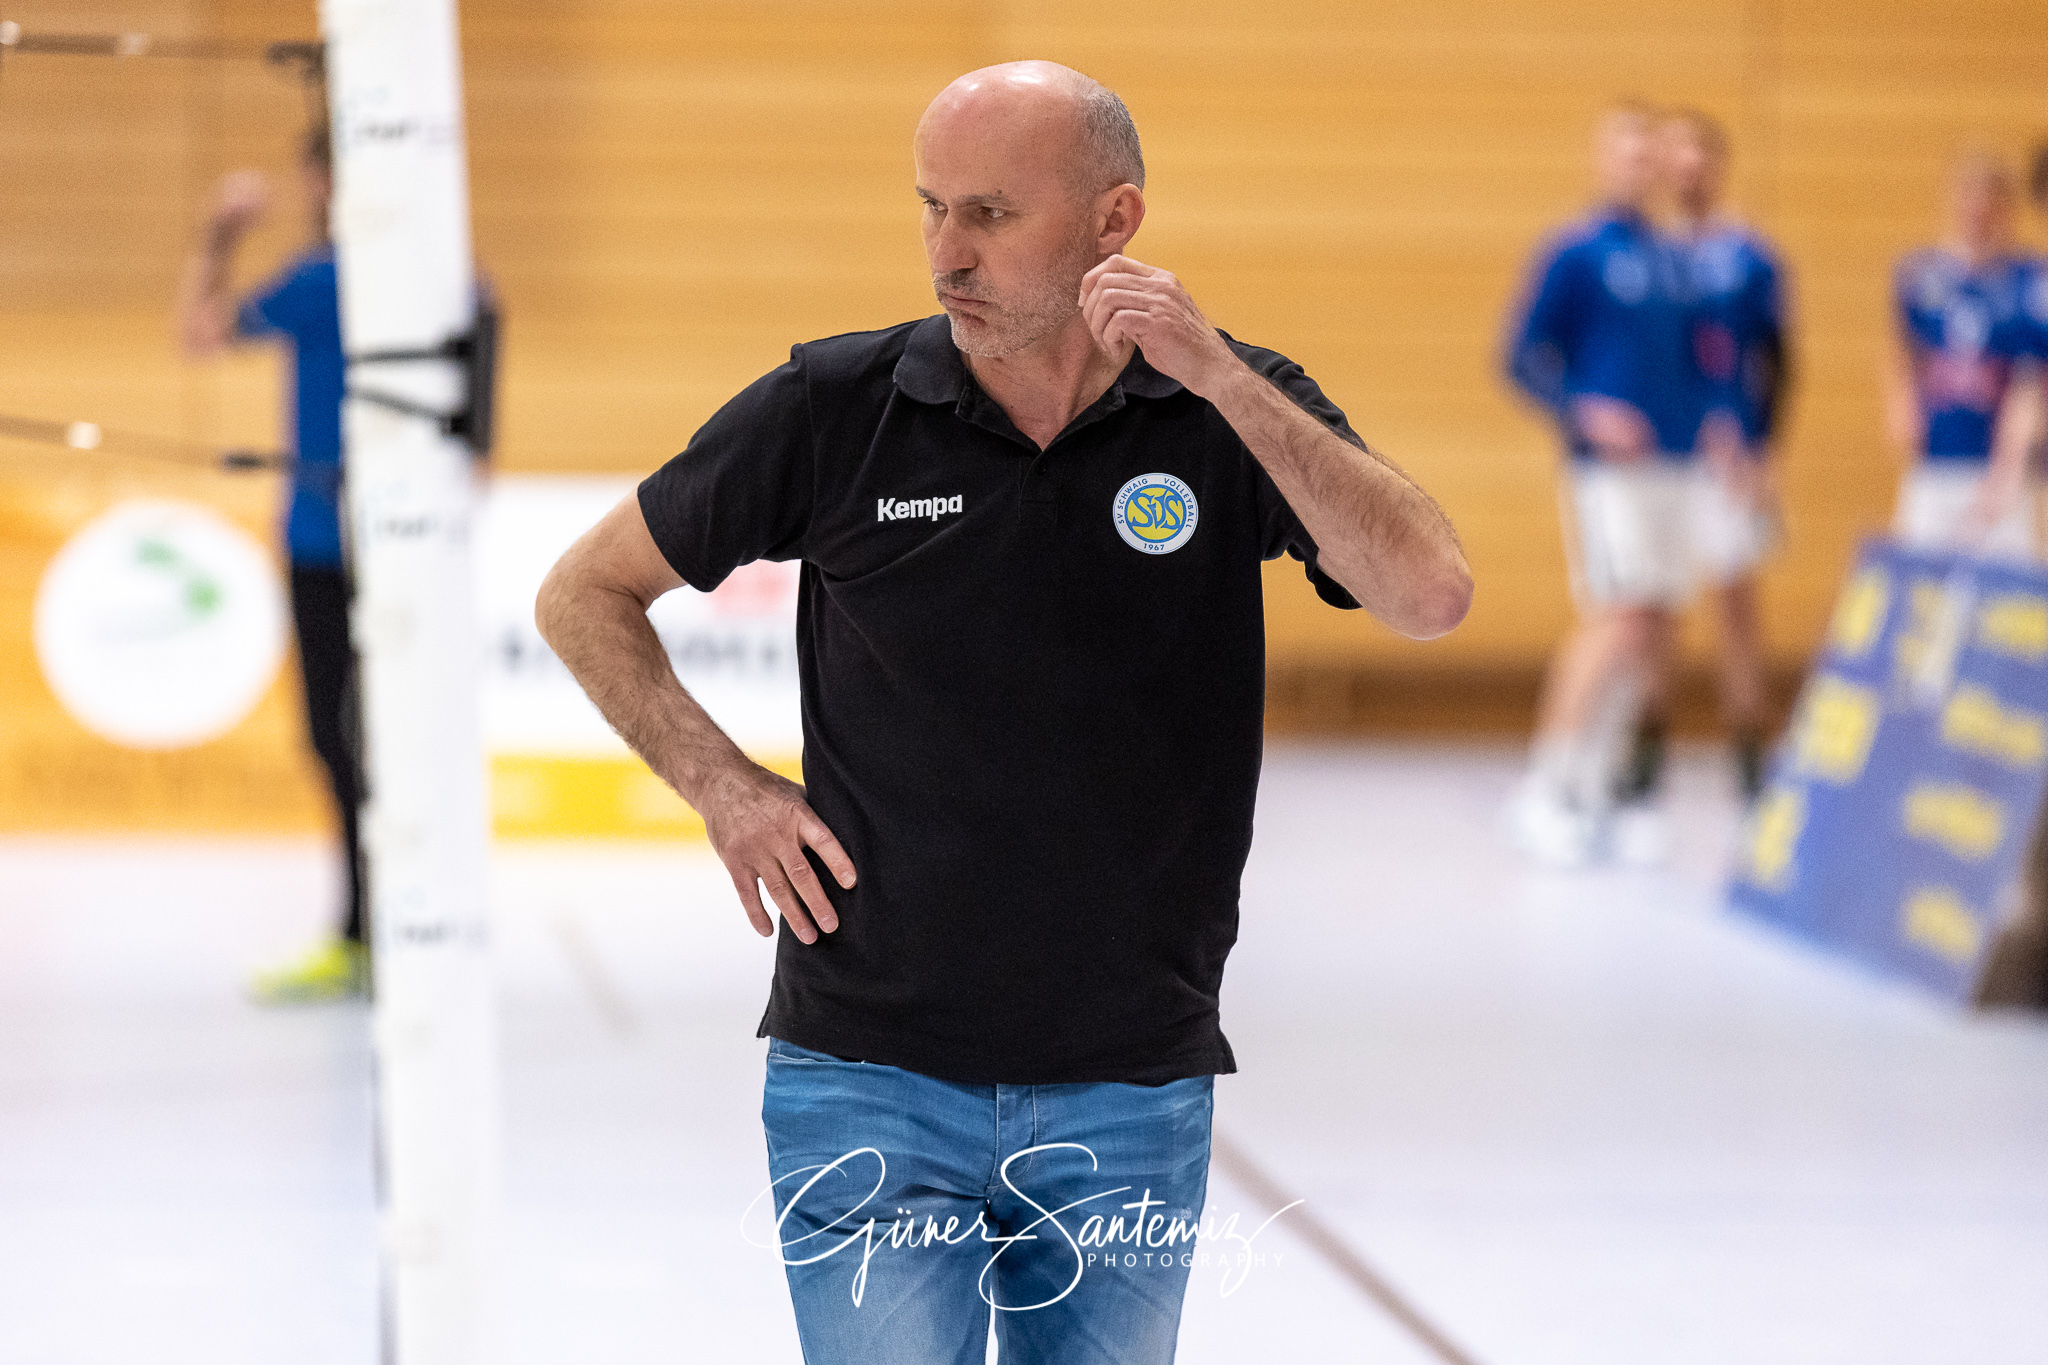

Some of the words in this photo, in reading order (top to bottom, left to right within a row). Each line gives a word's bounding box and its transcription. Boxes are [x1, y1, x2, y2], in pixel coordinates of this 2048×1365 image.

[877, 494, 963, 522] Kempa
[1117, 478, 1148, 510] SCHWAIG
[1164, 478, 1194, 528] VOLLEYBALL
[1117, 513, 1125, 524] SV
[1143, 543, 1165, 551] 1967
